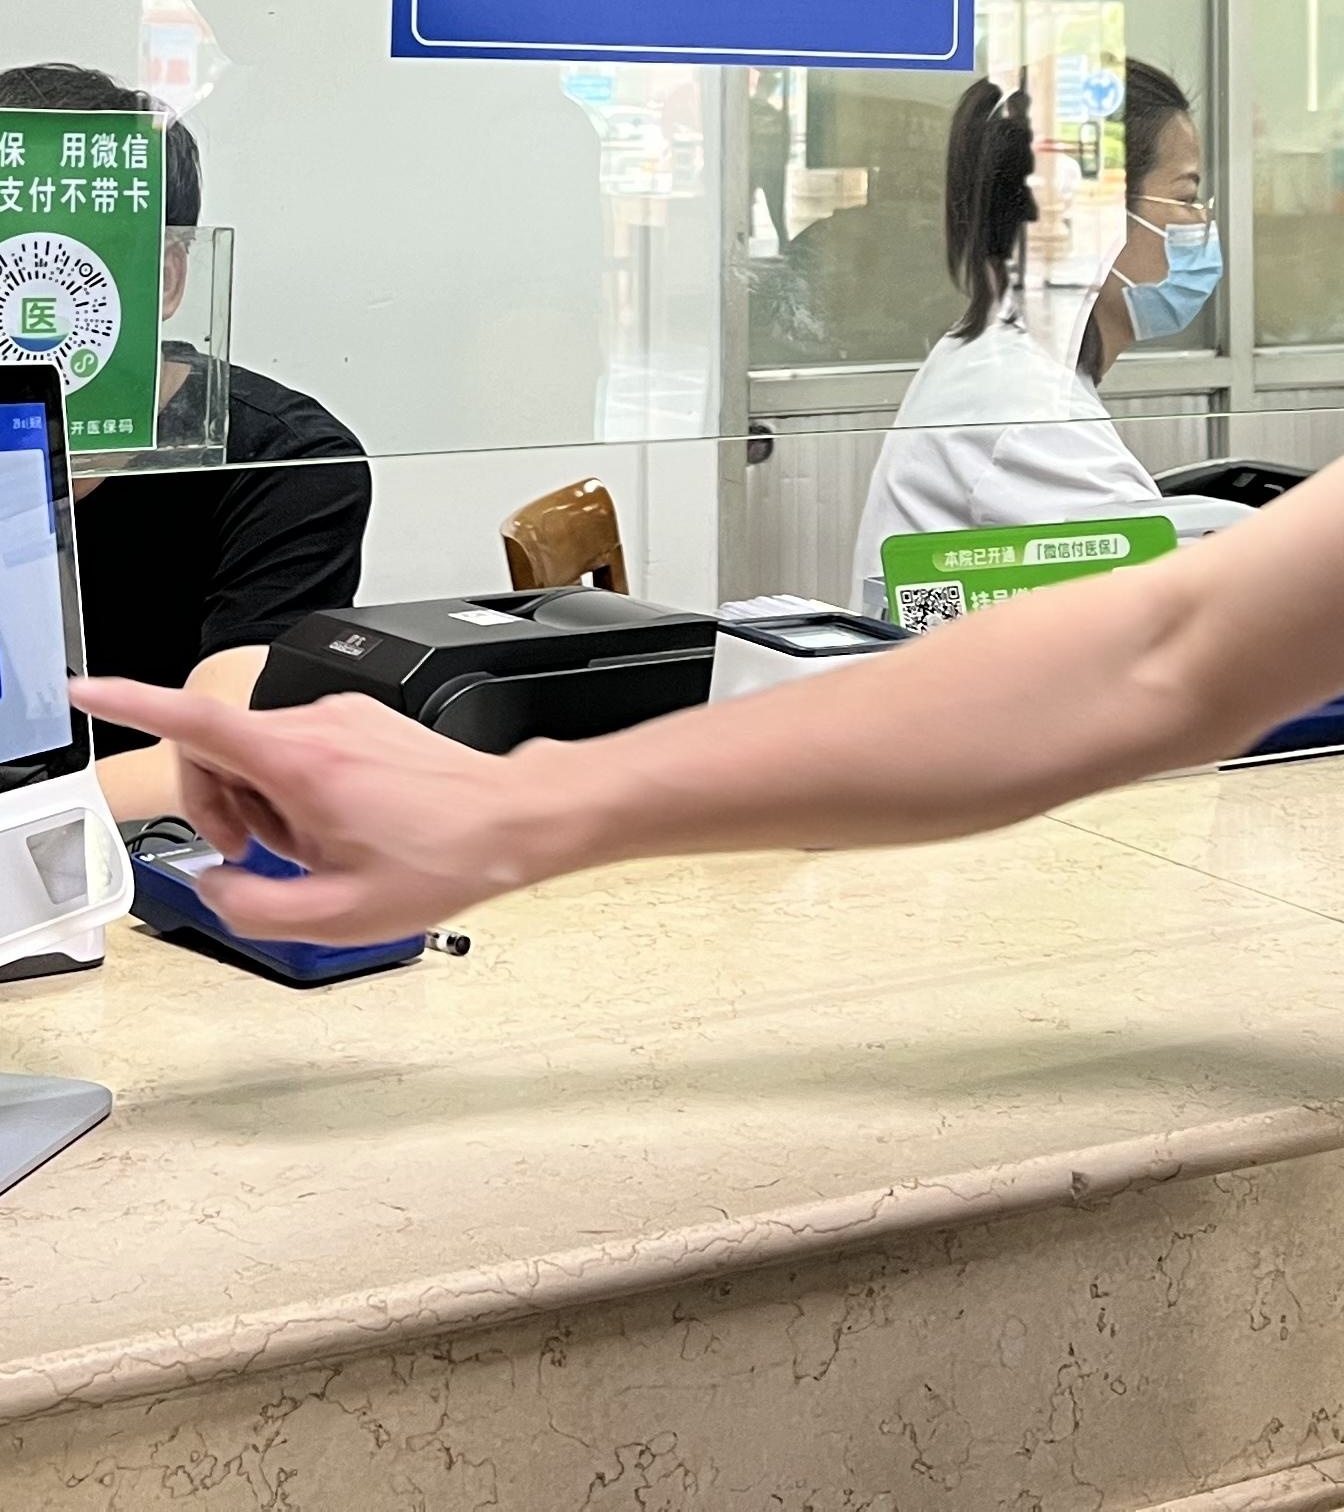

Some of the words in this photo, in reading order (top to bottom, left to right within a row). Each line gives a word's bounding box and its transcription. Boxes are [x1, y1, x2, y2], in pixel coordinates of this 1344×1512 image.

[60, 132, 149, 170] 用微信
[944, 546, 1016, 568] 本院已开通
